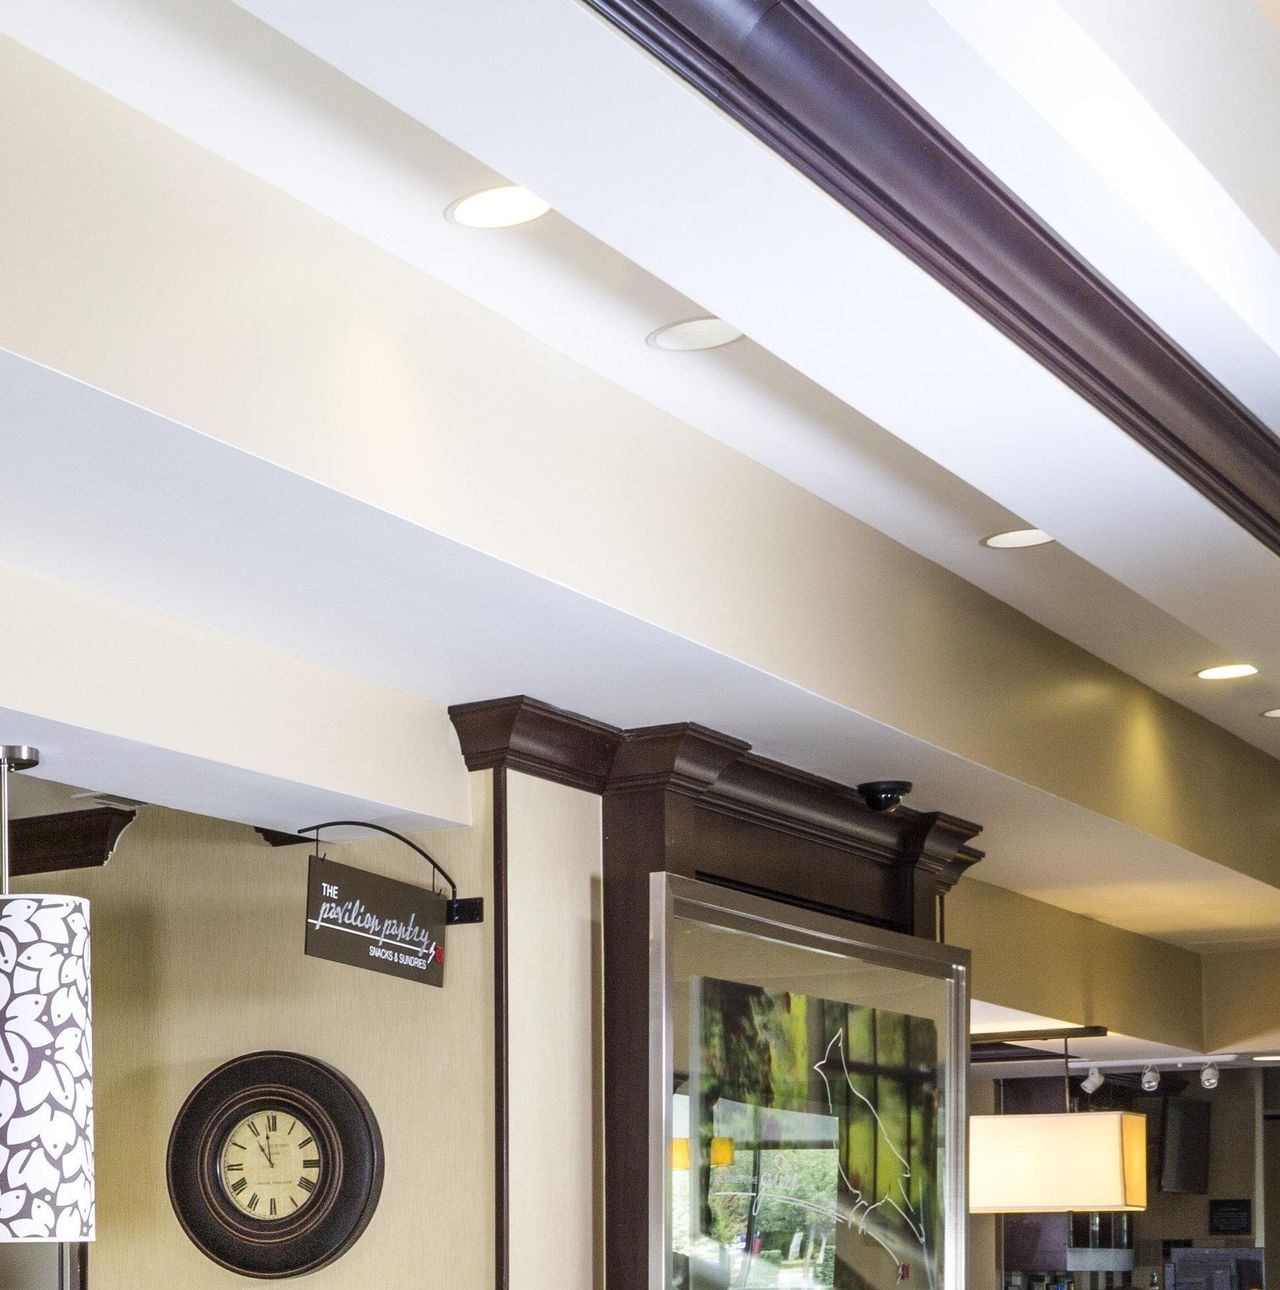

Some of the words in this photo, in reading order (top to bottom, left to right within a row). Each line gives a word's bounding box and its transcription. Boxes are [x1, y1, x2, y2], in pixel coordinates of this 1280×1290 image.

[321, 882, 339, 899] THE
[315, 899, 382, 934] pavilion
[377, 912, 431, 958] pantry
[368, 945, 394, 962] SNACKS
[393, 952, 399, 963] &
[398, 953, 427, 970] SUNDRIES
